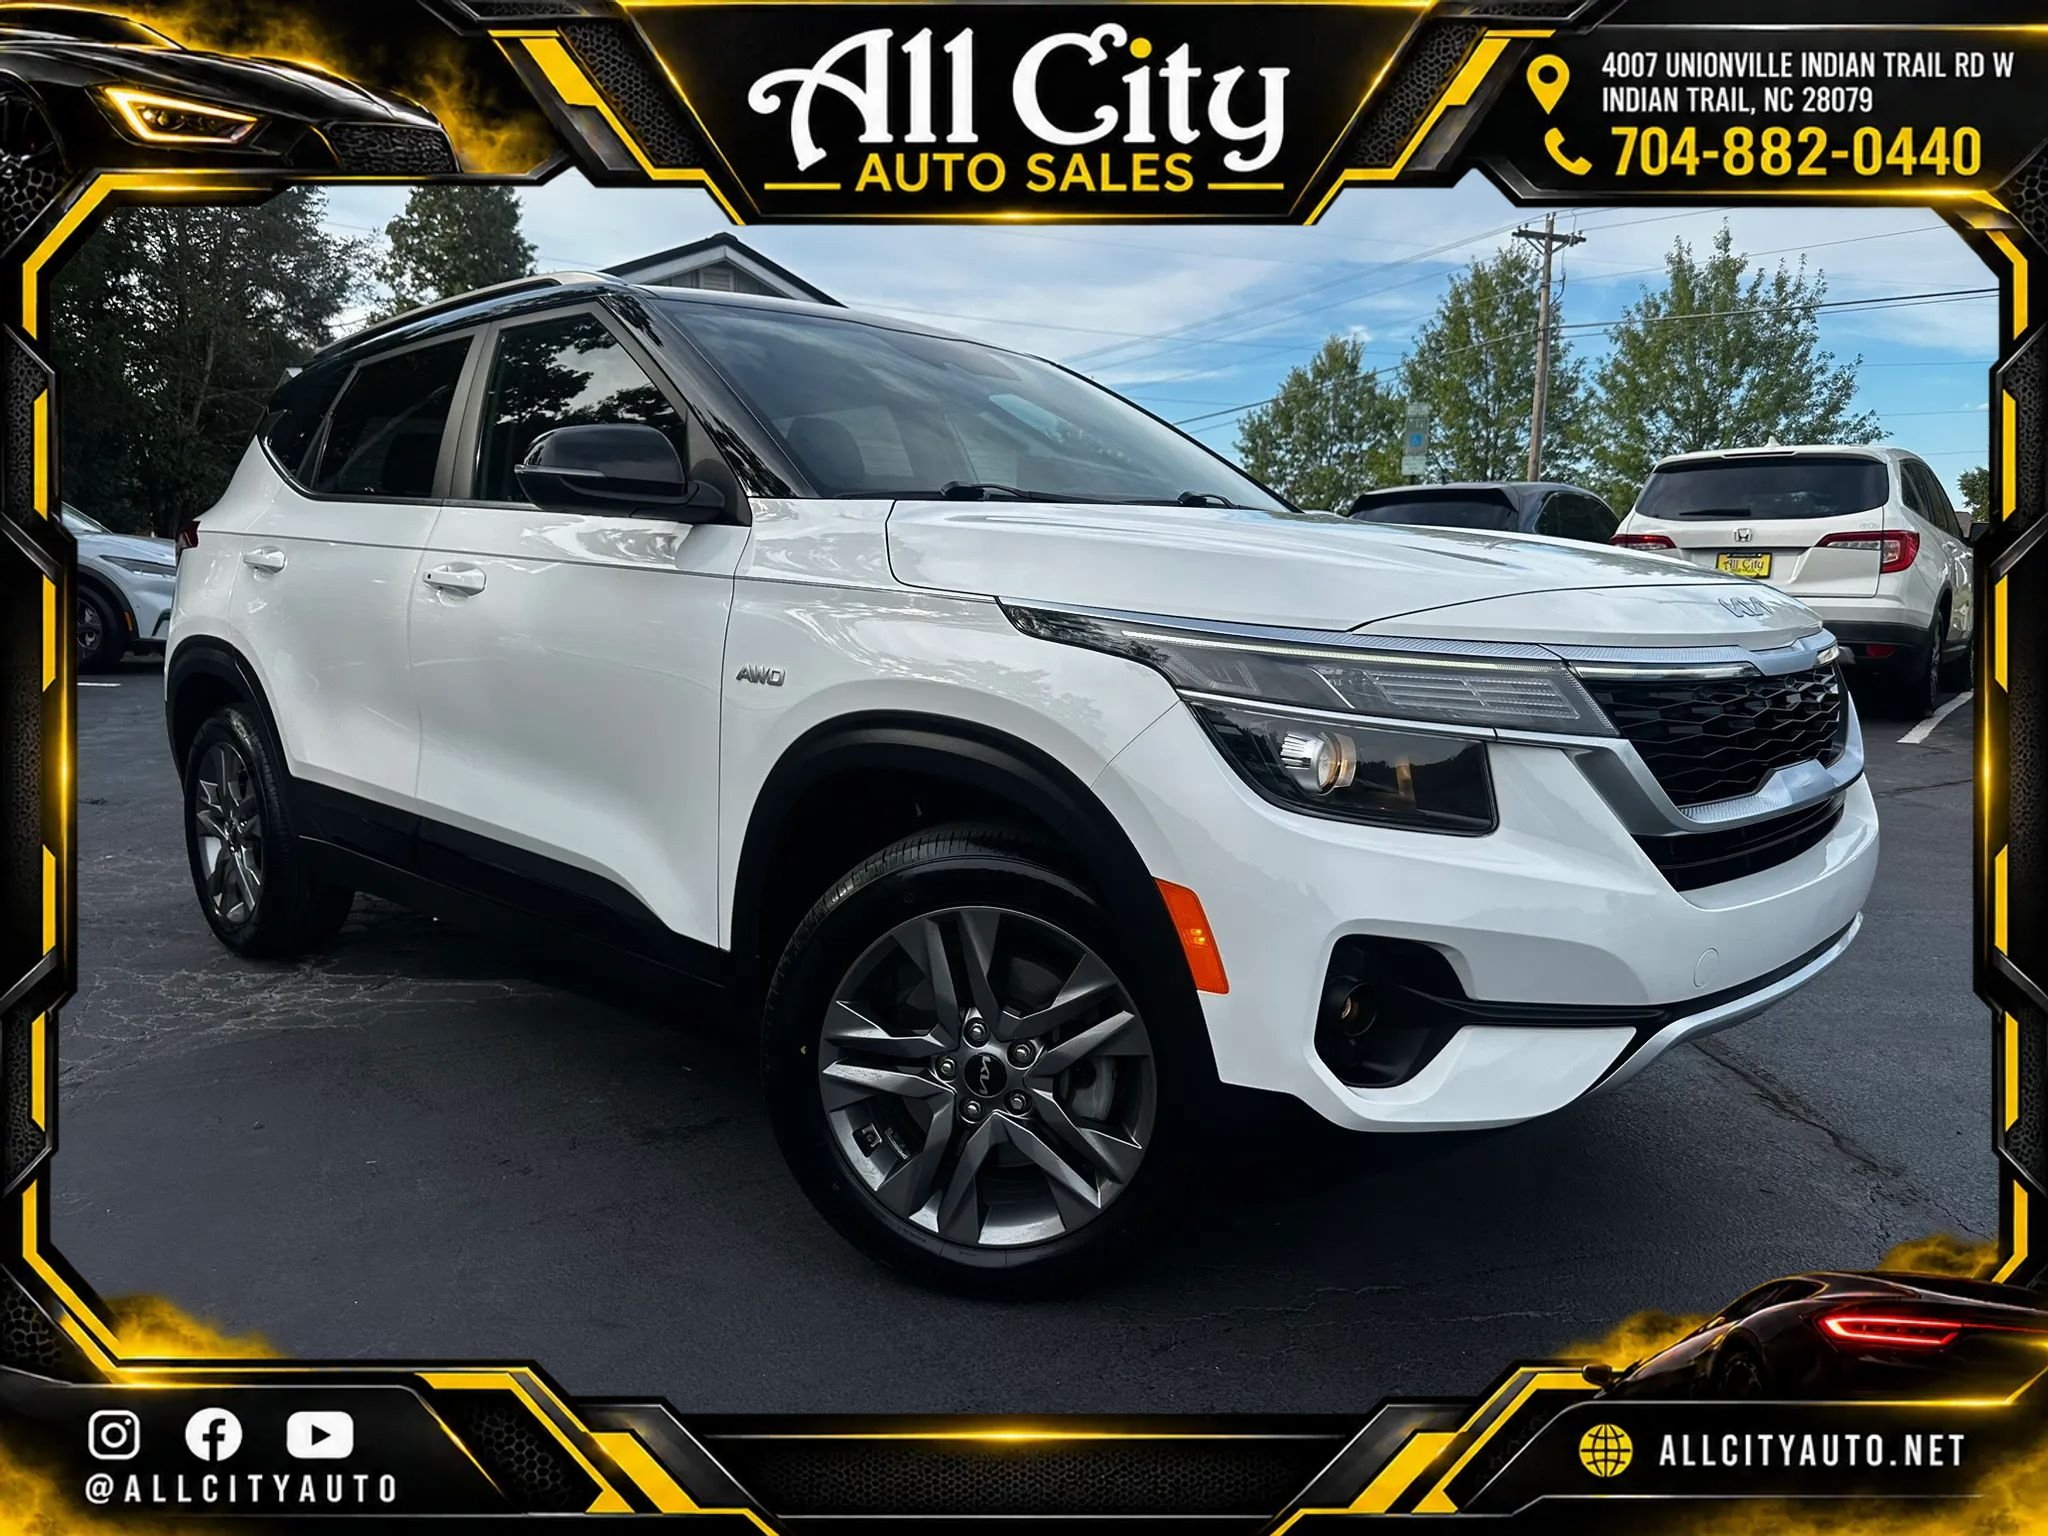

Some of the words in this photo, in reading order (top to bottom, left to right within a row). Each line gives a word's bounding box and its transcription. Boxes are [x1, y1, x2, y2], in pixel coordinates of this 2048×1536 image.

[1723, 559, 1738, 571] All
[1742, 558, 1764, 571] City
[735, 664, 786, 687] AWD
